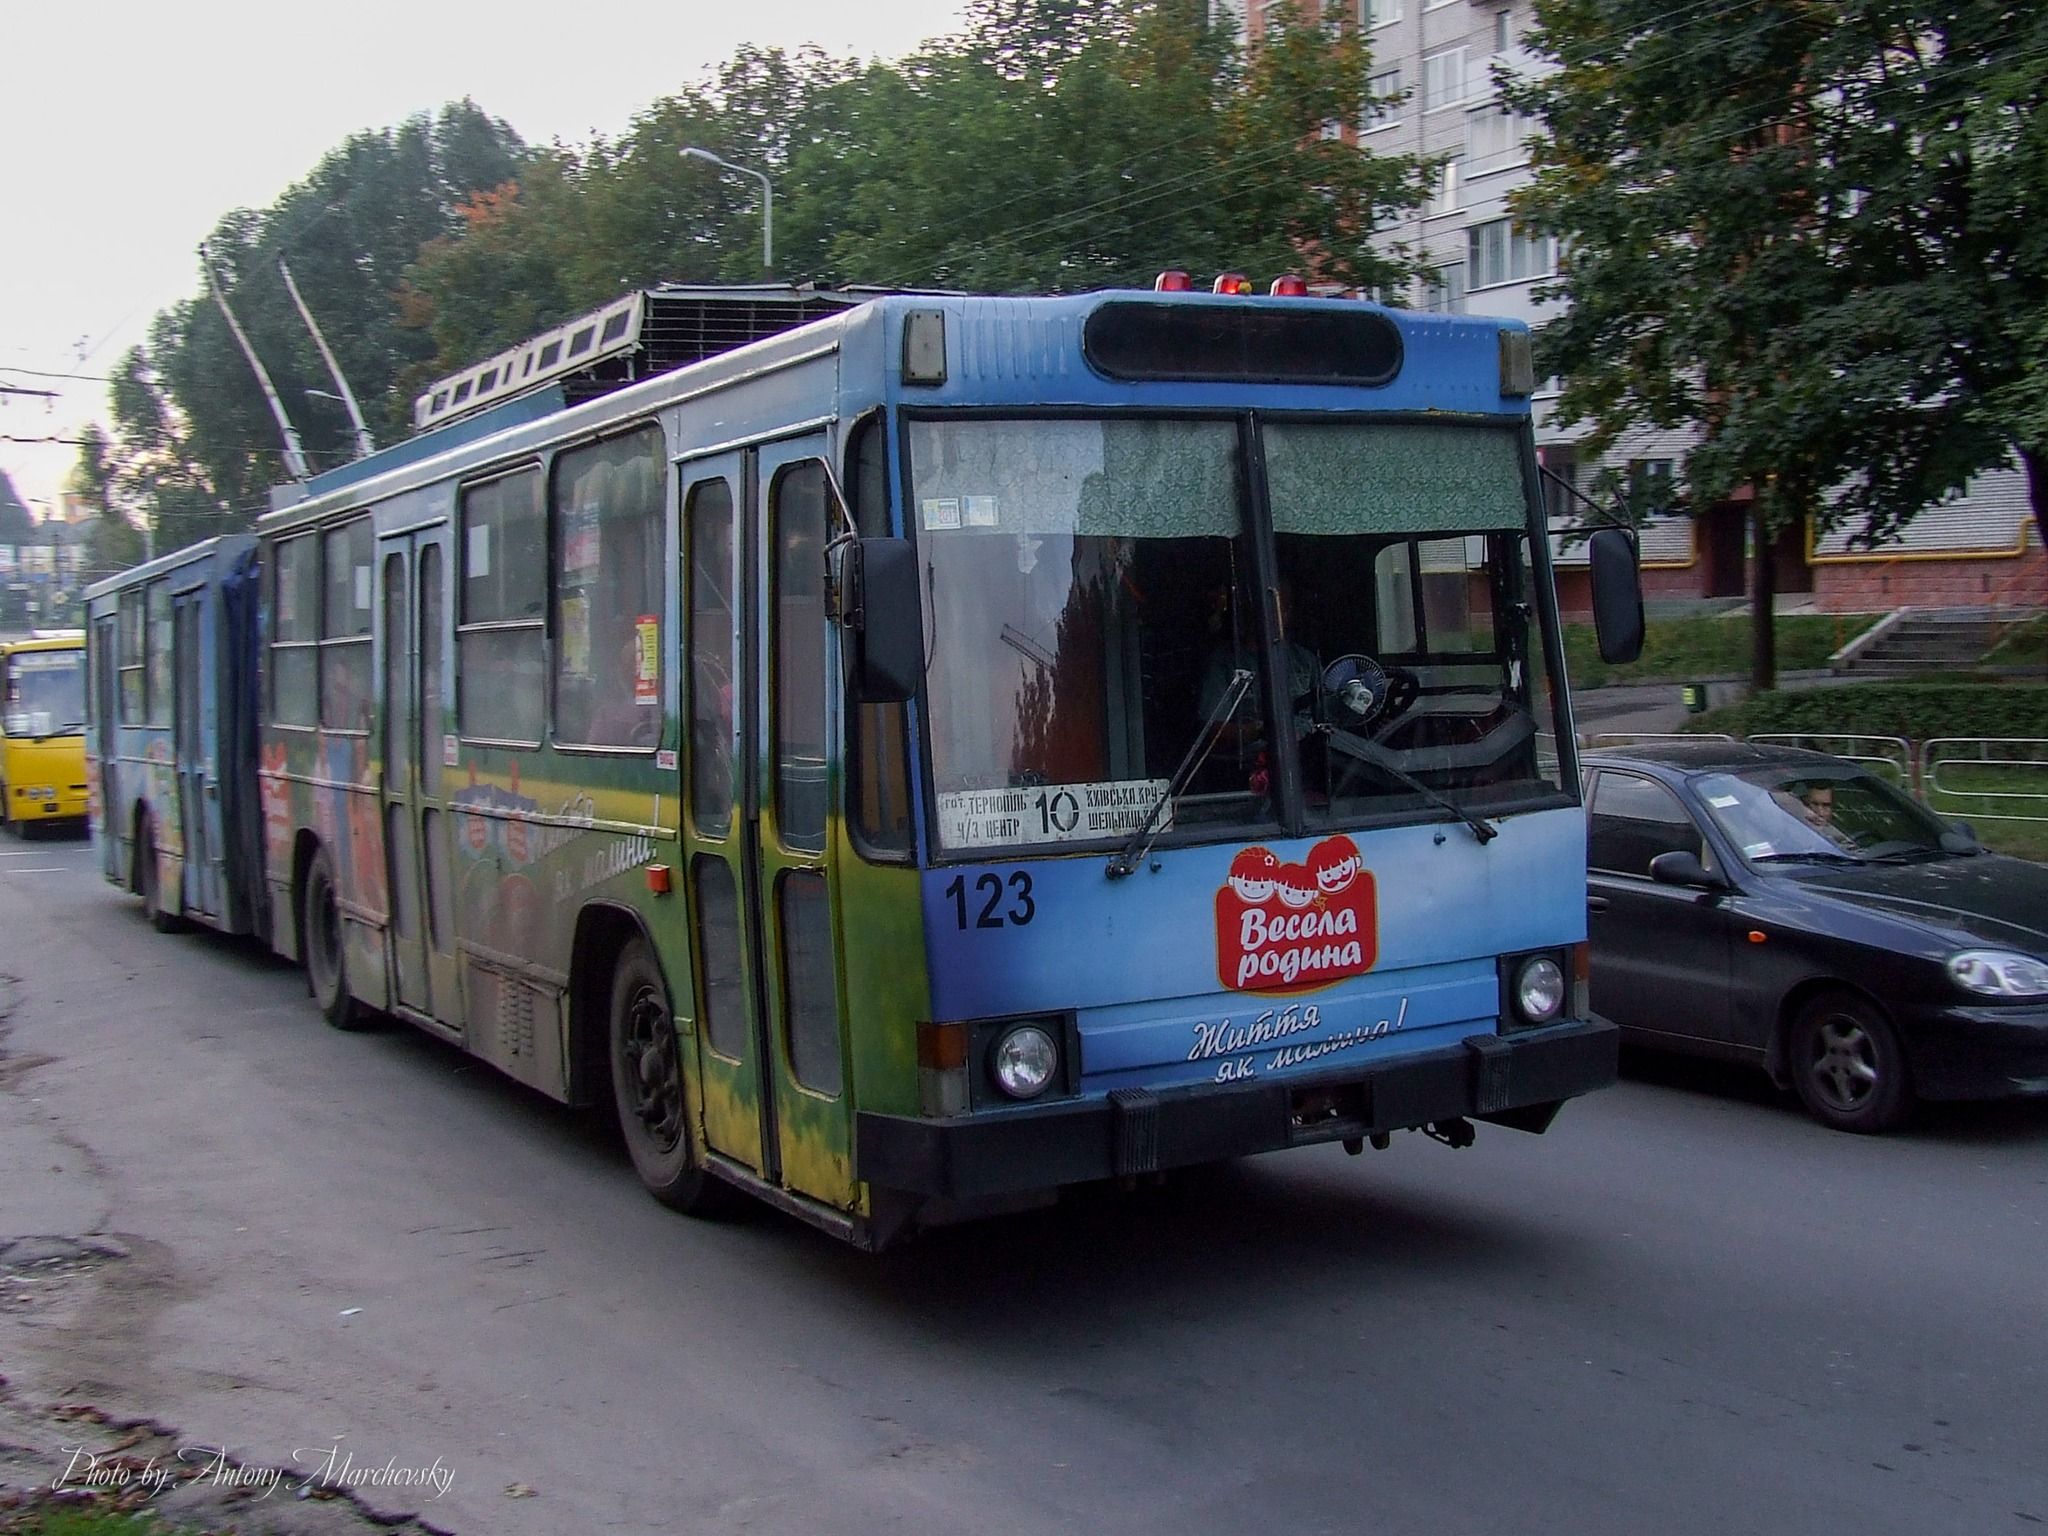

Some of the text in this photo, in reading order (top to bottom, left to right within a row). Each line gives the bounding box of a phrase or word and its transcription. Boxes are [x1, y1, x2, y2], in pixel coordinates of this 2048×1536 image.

[968, 792, 1027, 815] ТЕРНОПІЛЬ
[1035, 790, 1079, 835] 10
[986, 818, 1020, 840] ЦЕНТР
[946, 870, 1035, 930] 123
[1240, 908, 1357, 950] Весела
[1237, 941, 1361, 987] родина
[1188, 1004, 1320, 1060] Життя
[1215, 1056, 1254, 1083] як
